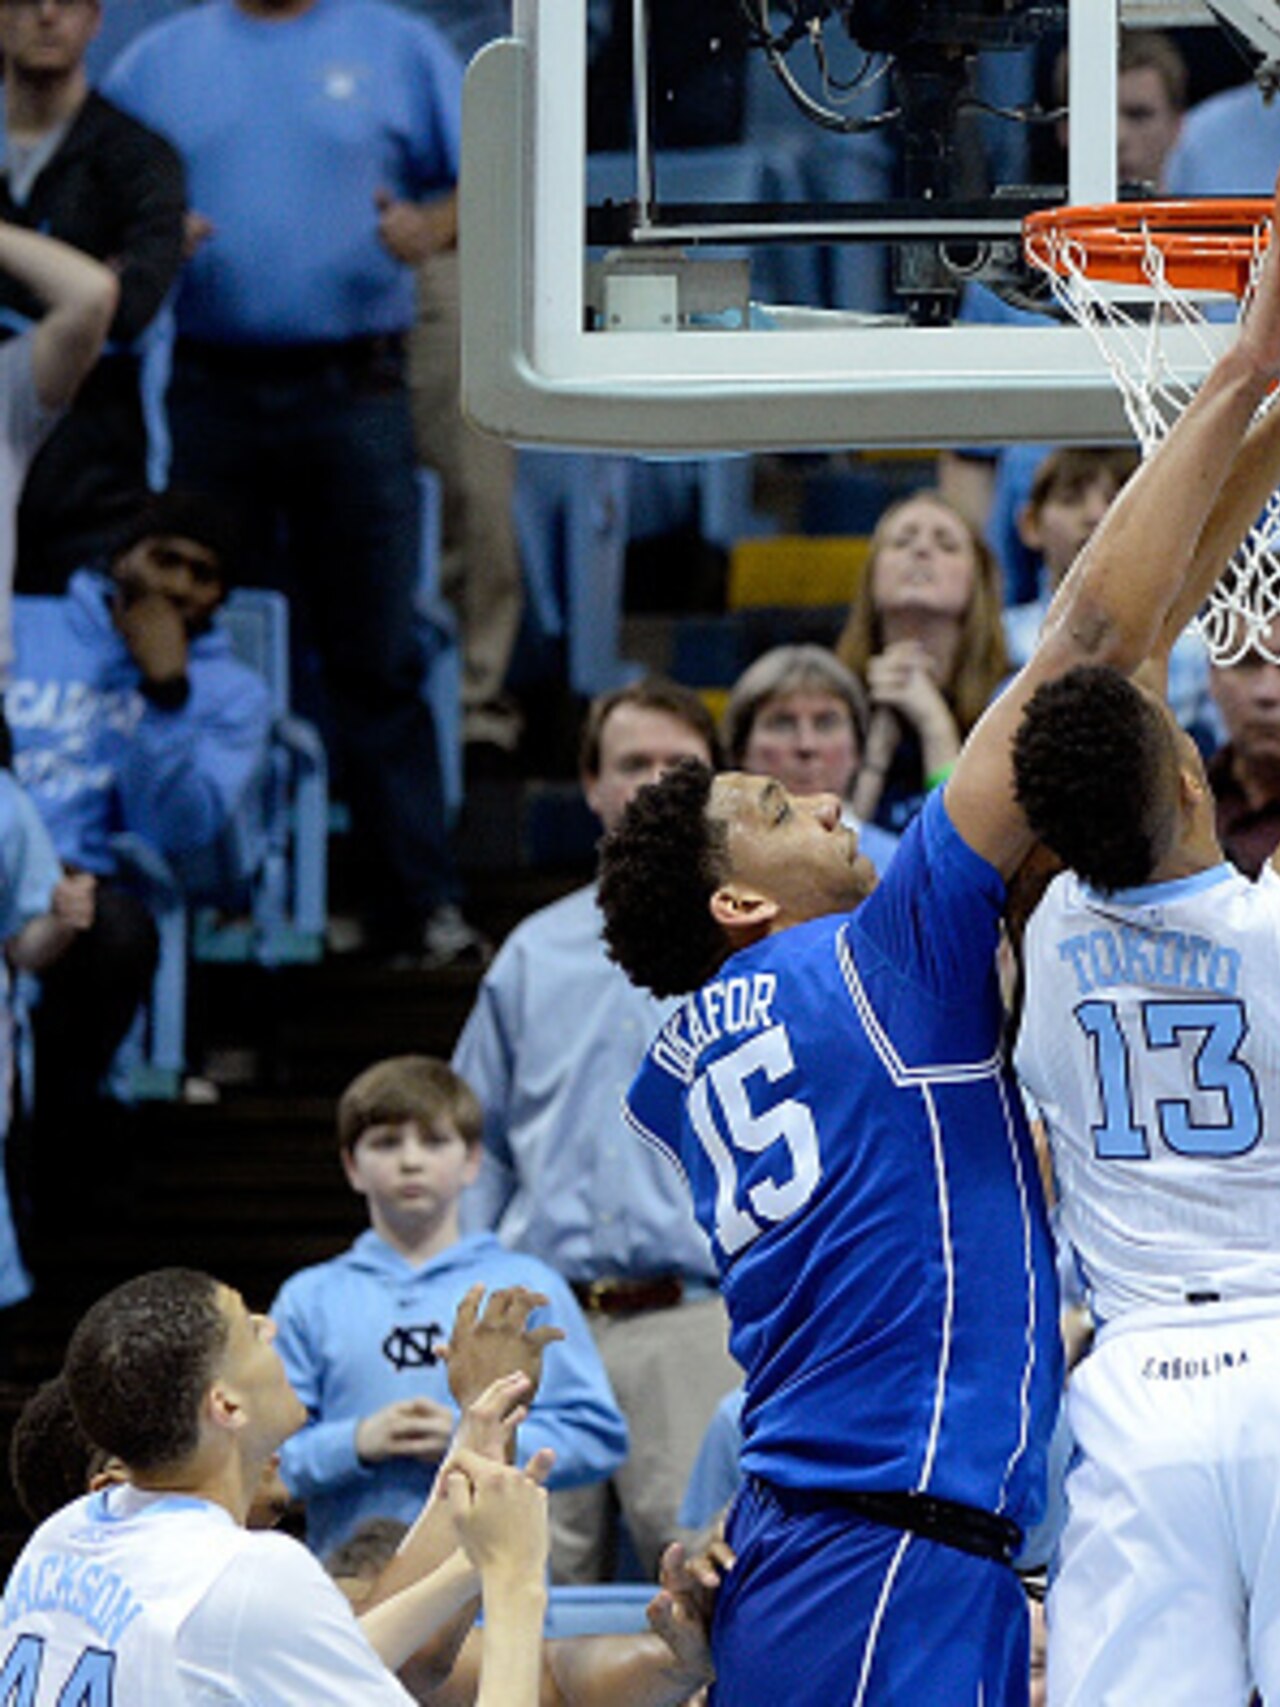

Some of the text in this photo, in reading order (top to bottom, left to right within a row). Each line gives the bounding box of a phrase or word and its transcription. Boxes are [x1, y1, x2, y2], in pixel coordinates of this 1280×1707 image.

[1057, 925, 1242, 996] TOKOTO
[652, 973, 777, 1085] OKAFOR
[1073, 999, 1264, 1160] 13
[687, 1022, 822, 1256] 15
